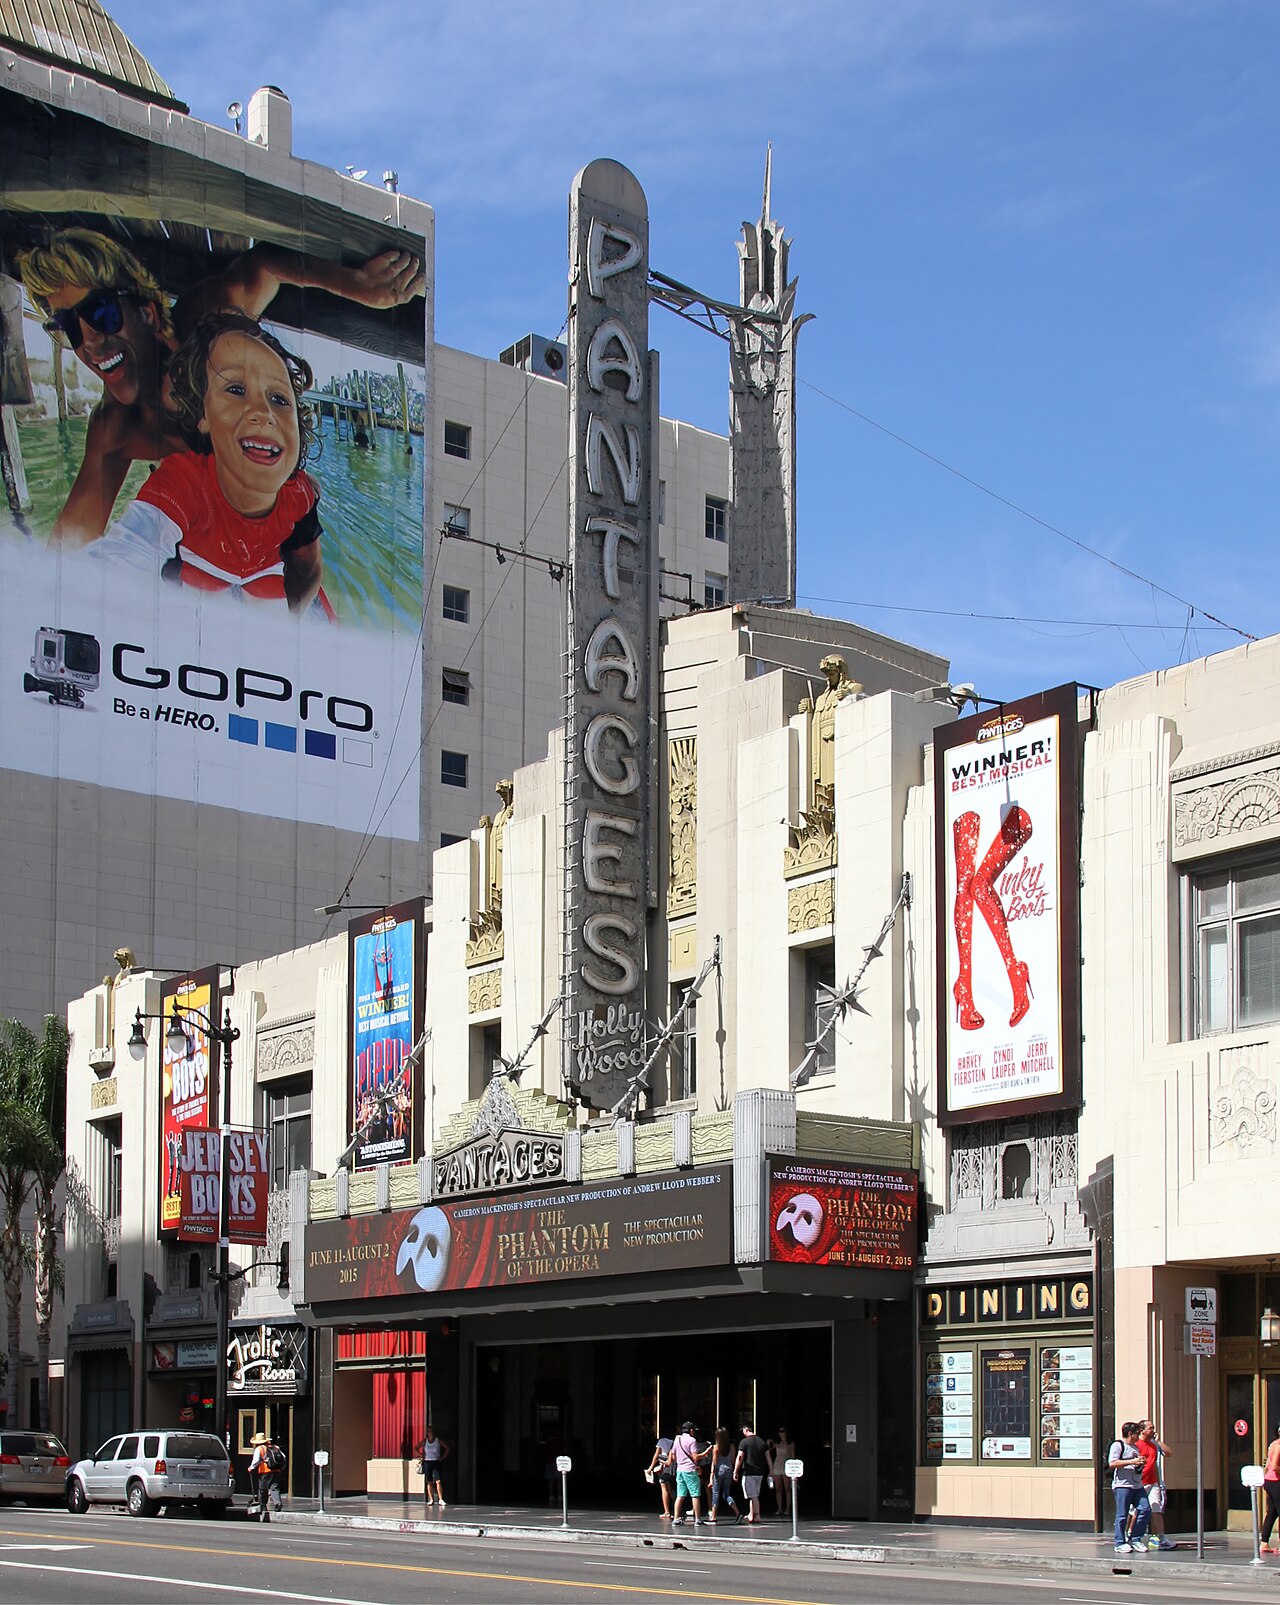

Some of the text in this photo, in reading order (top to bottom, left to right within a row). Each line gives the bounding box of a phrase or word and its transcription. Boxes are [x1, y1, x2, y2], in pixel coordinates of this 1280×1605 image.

[581, 214, 645, 997] PANTAGES
[112, 642, 374, 733] GoPro
[113, 697, 220, 733] Be a HERO.
[977, 717, 1024, 741] PANTAGES
[951, 737, 1052, 780] WINNER!
[951, 753, 1052, 793] BEST MUSICAL
[991, 778, 1005, 786] TONY
[1006, 771, 1024, 781] AWARD
[1006, 889, 1053, 922] Boots
[358, 993, 409, 1019] WINNER!
[358, 1009, 410, 1033] BEST MUSICAL REVIVAL
[578, 1003, 644, 1045] Holly
[993, 1047, 1014, 1064] CYNDI
[1026, 1041, 1048, 1058] JERRY
[572, 1037, 646, 1083] Wood
[957, 1053, 982, 1071] HARVEY
[1021, 1056, 1054, 1075] MITCHELL
[172, 1051, 206, 1105] BOYS
[954, 1068, 986, 1087] FIERSTEIN
[991, 1062, 1016, 1080] LAUPER
[433, 1139, 564, 1193] PANTAGES
[785, 1165, 903, 1184] CAMERON MACKINTOSH'S SPECTACULAR
[773, 1172, 915, 1192] NEW PRODUCTION OF ANDREW LLOYD WEBBER'S
[166, 1200, 178, 1212] BEST
[453, 1174, 721, 1219] CAMERON MACKINTOSH'S SPECTACULAR NEW PRODUCTION OF ANDREW LLOYD WEBBER'S
[861, 1191, 881, 1202] THE
[537, 1209, 566, 1228] THE
[827, 1198, 912, 1222] PHANTOM
[183, 1224, 215, 1234] PANTAGES
[624, 1213, 704, 1233] THE SPECTACULAR
[834, 1215, 905, 1231] OF THE OPERA
[497, 1221, 610, 1261] PHANTOM
[623, 1228, 704, 1248] NEW PRODUCTION
[840, 1238, 900, 1249] NEW PRODUCTION
[841, 1229, 900, 1241] THE SPECTACULAR
[310, 1249, 332, 1267] JUNE
[384, 1243, 390, 1257] 2
[828, 1251, 912, 1266] JUNE 11-AUGUST 2, 2015
[507, 1253, 600, 1278] OF THE OPERA
[339, 1268, 358, 1284] 2015
[927, 1282, 1090, 1318] DINING
[1193, 1310, 1208, 1318] ZONE
[226, 1324, 282, 1391] Frolic
[1206, 1346, 1214, 1354] 15
[261, 1365, 296, 1381] Room
